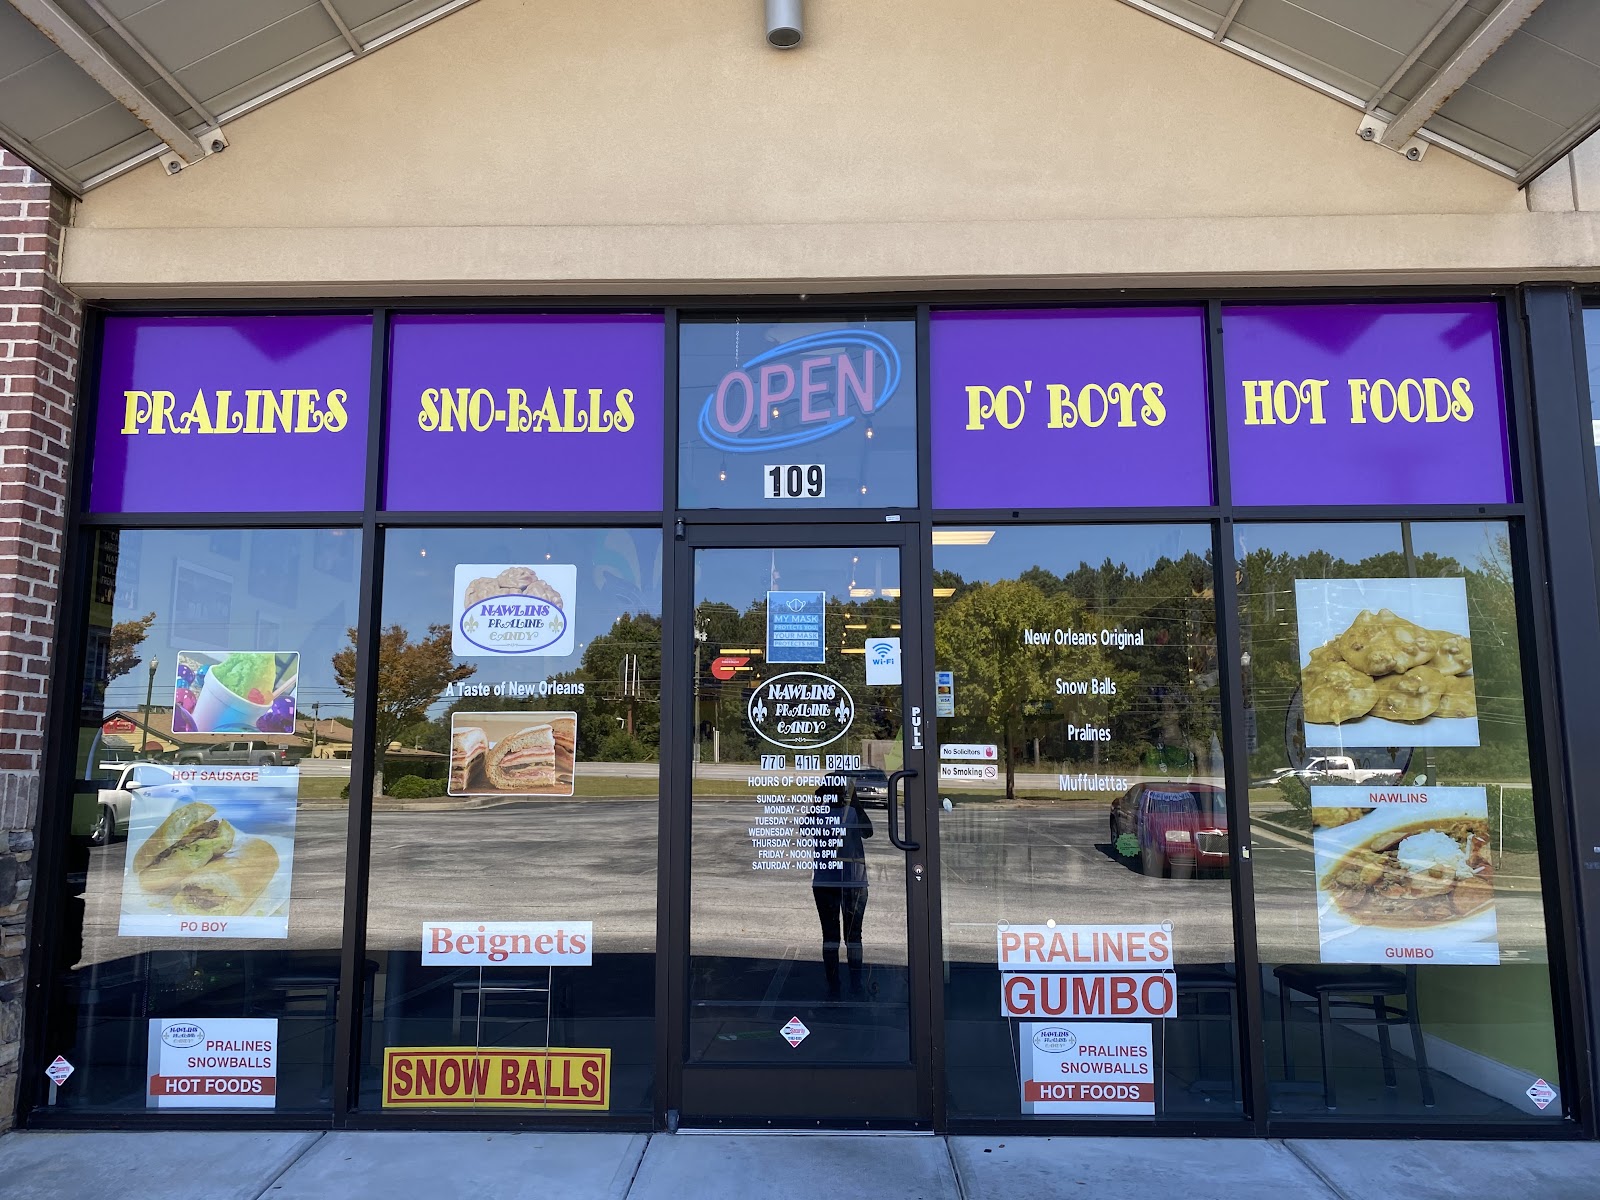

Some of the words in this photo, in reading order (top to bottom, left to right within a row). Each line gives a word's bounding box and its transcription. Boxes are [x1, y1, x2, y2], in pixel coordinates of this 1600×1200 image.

[716, 349, 874, 433] OPEN
[965, 380, 1032, 430] PO'
[1046, 381, 1167, 428] BOYS
[1242, 379, 1330, 425] HOT
[1348, 377, 1474, 423] FOODS
[121, 388, 348, 435] PRALINES
[418, 387, 635, 433] SNO-BALLS
[769, 465, 823, 497] 109
[480, 604, 550, 617] NAWLINS
[487, 618, 545, 629] PRALINE
[774, 614, 789, 623] MY
[791, 614, 818, 623] MASK
[489, 631, 539, 641] CANDY
[1024, 629, 1050, 645] New
[1054, 628, 1097, 646] Orleans
[1101, 628, 1144, 650] Original
[445, 682, 455, 697] A
[456, 681, 491, 697] Taste
[493, 680, 506, 696] of
[509, 681, 536, 696] New
[538, 680, 585, 695] Orleans
[768, 684, 835, 701] NAWLINS
[1056, 678, 1088, 695] Snow
[1091, 677, 1116, 695] Balls
[775, 703, 831, 717] PRALINE
[777, 721, 826, 734] CANDY
[912, 706, 921, 746] PULL
[1067, 724, 1111, 741] Pralines
[762, 756, 785, 769] 770
[796, 756, 820, 769] 417
[828, 756, 860, 769] 8240
[172, 770, 197, 782] HOT
[200, 770, 259, 782] SAUSAGE
[942, 767, 951, 776] No
[953, 767, 983, 778] Smoking
[748, 776, 779, 787] HOURS
[781, 776, 794, 787] OF
[796, 776, 847, 787] OPERATION
[1059, 773, 1128, 792] Muffulettas
[756, 794, 786, 803] SUNDAY
[791, 794, 813, 803] NOON
[814, 794, 822, 803] to
[1369, 792, 1428, 804] NAWLINS
[764, 805, 796, 814] MONDAY
[800, 805, 831, 814] CLOSED
[755, 816, 788, 825] TUESDAY
[793, 816, 815, 825] NOON
[816, 816, 824, 825] to
[825, 816, 840, 825] 7PM
[748, 827, 794, 836] WEDNESDAY
[799, 827, 821, 836] NOON
[822, 827, 830, 836] to
[831, 827, 847, 836] 7PM
[752, 838, 791, 847] THURSDAY
[796, 838, 818, 847] NOON
[819, 838, 827, 847] to
[828, 838, 844, 847] 8PM
[758, 849, 785, 858] FRIDAY
[790, 849, 811, 858] NOON
[813, 849, 820, 858] to
[821, 849, 837, 858] 8PM
[752, 861, 791, 870] SATURDAY
[796, 861, 818, 870] NOON
[819, 861, 827, 870] to
[828, 861, 844, 870] 8PM
[180, 921, 199, 933] PO
[201, 921, 228, 933] BOY
[428, 925, 587, 962] Beignets
[1001, 931, 1169, 963] PRALINES
[1385, 946, 1435, 959] GUMBO
[1004, 976, 1174, 1015] GUMBO
[206, 1040, 272, 1052] PRALINES
[1079, 1045, 1148, 1057] PRALINES
[187, 1056, 272, 1069] SNOWBALLS
[1061, 1062, 1148, 1074] SNOWBALLS
[393, 1058, 491, 1096] SNOW
[500, 1059, 600, 1097] BALLS
[165, 1078, 201, 1093] HOT
[205, 1078, 262, 1093] FOODS
[1040, 1084, 1076, 1099] HOT
[1080, 1085, 1140, 1100] FOODS
